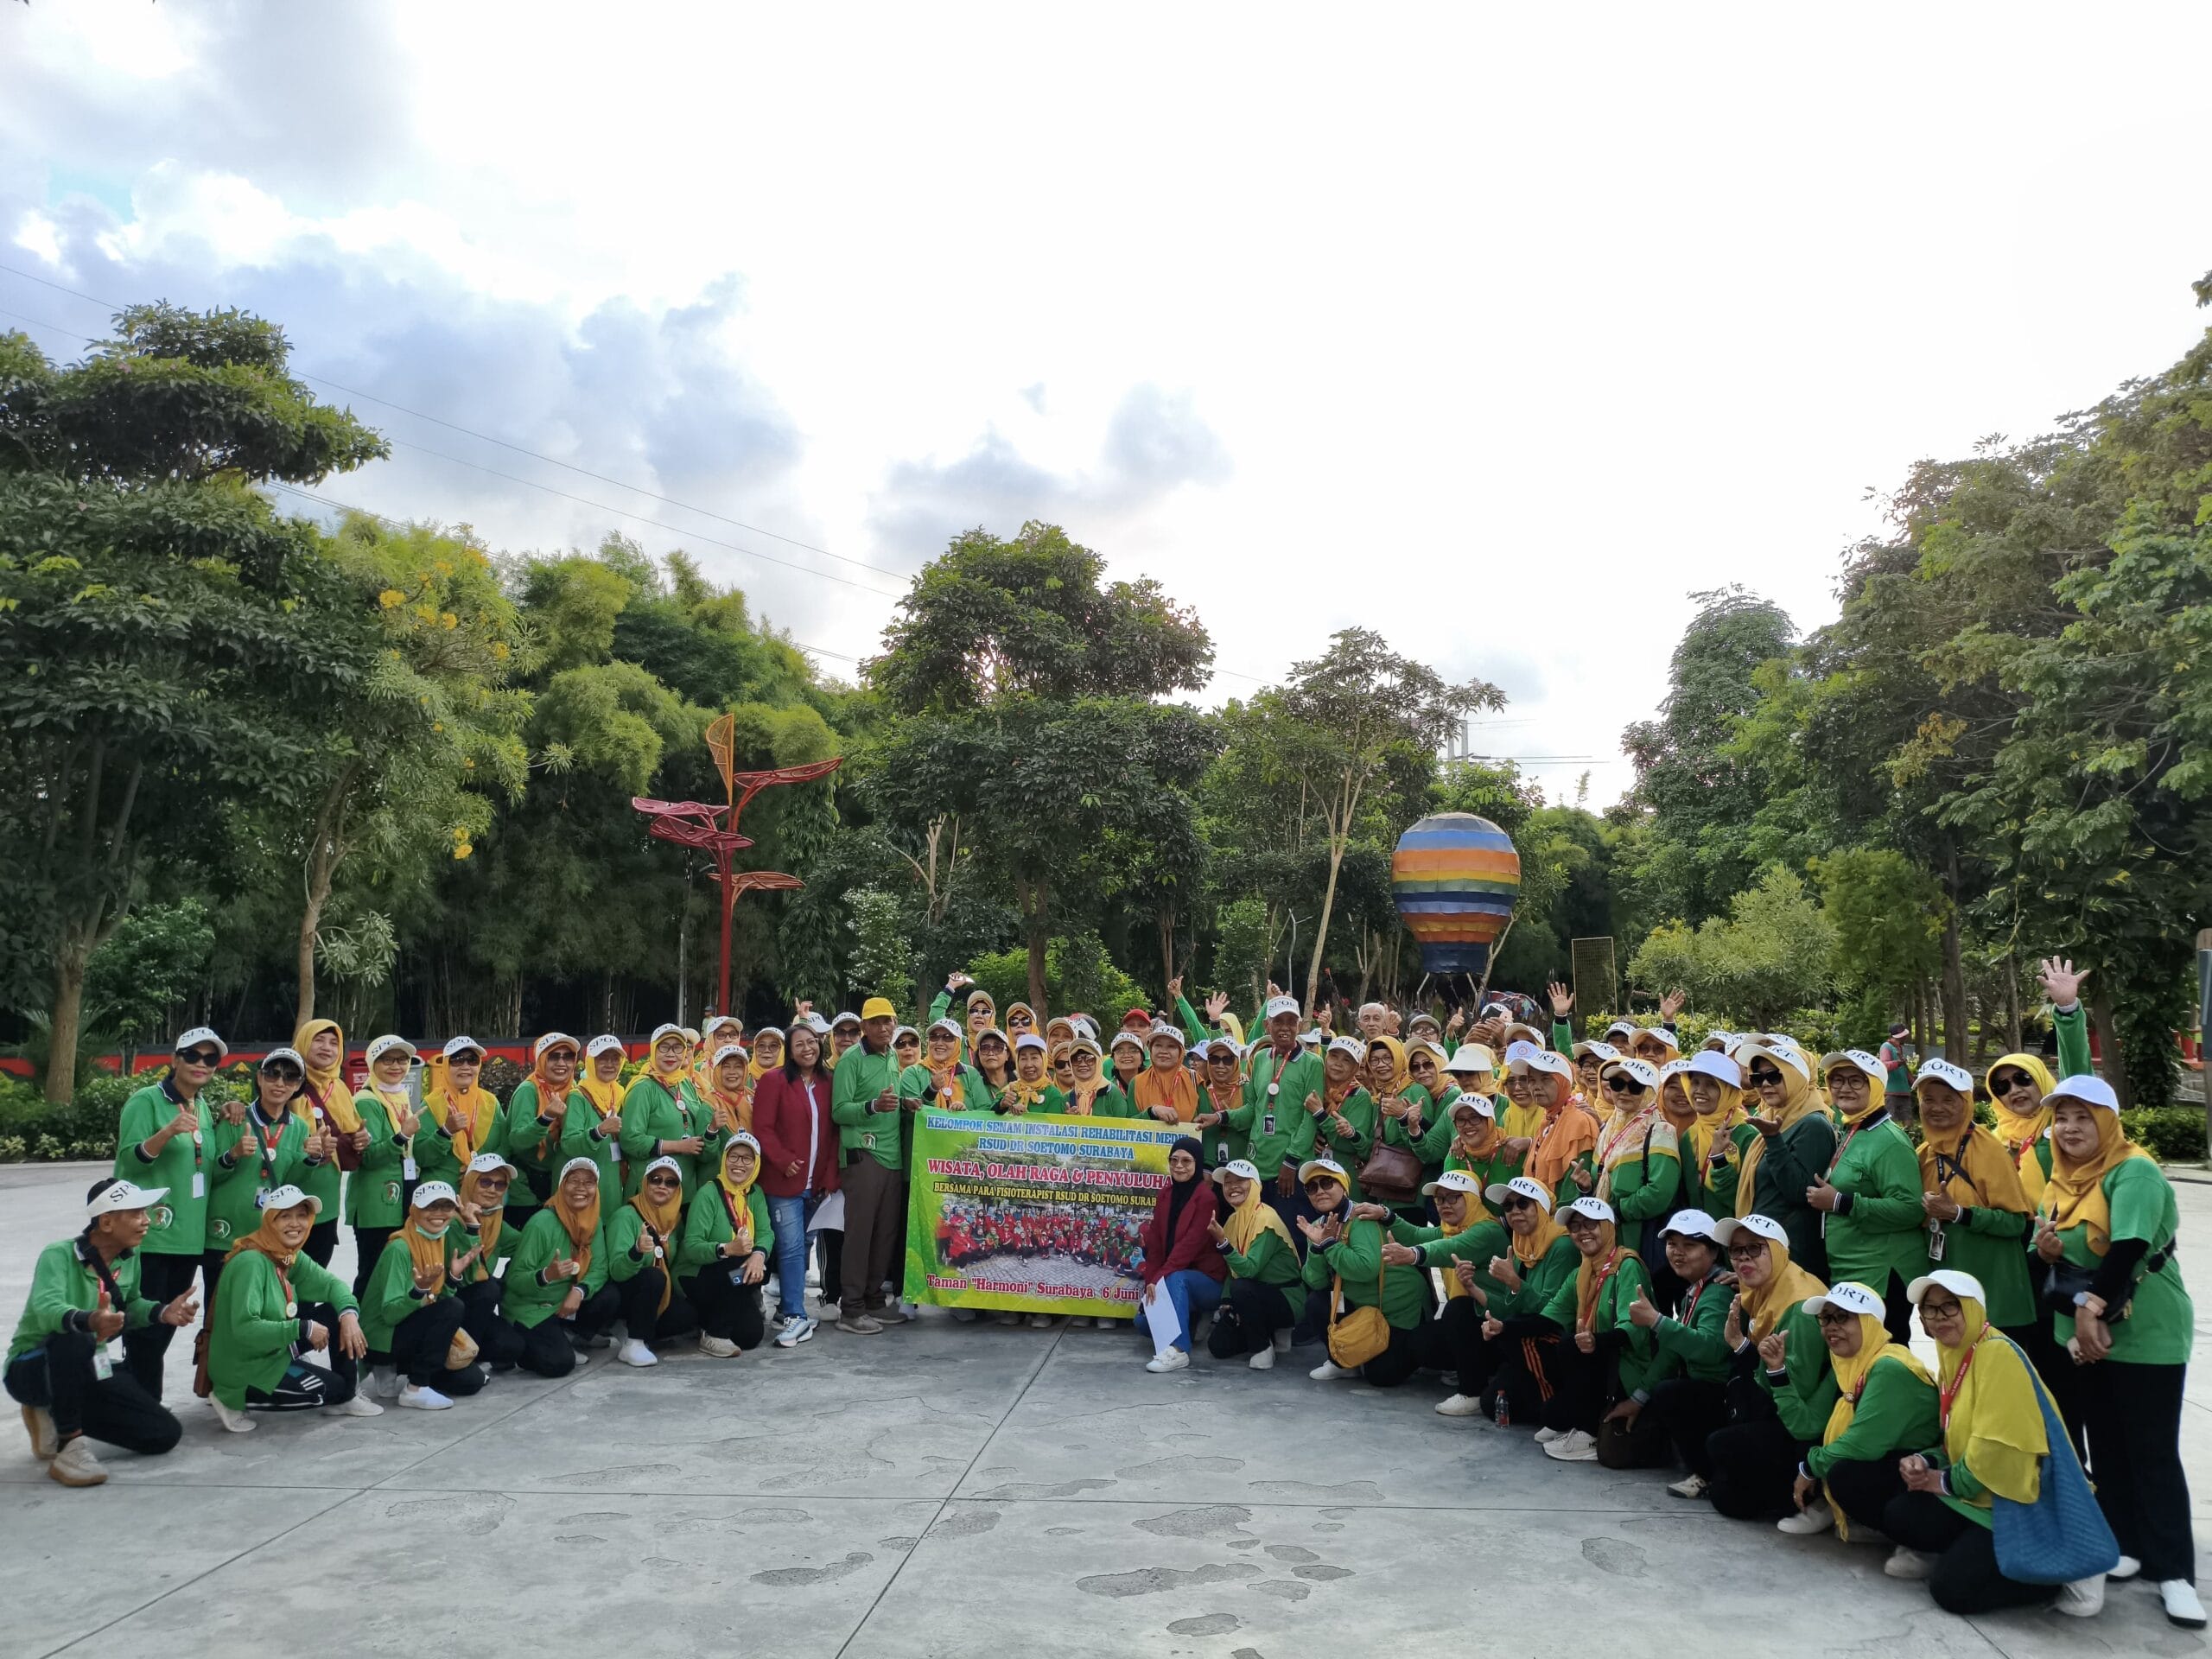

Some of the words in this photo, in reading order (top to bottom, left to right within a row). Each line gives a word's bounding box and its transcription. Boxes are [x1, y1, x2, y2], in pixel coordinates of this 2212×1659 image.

[1624, 1061, 1654, 1077] ORT
[1459, 1096, 1490, 1108] ORT
[927, 1116, 983, 1132] KELOMPOK
[986, 1121, 1022, 1134] SENAM
[1025, 1123, 1078, 1138] INSTALASI
[1081, 1127, 1153, 1143] REHABILITASI
[1155, 1132, 1190, 1145] MED
[978, 1138, 1007, 1151] RSUD
[1009, 1140, 1025, 1152] DR
[1027, 1141, 1077, 1156] SOETOMO
[1079, 1144, 1135, 1160] SURABAYA
[474, 1153, 504, 1165] SPO
[927, 1159, 985, 1179] WISATA,
[987, 1163, 1027, 1179] OLAH
[1029, 1165, 1069, 1183] RAGA
[1071, 1168, 1084, 1183] &
[1085, 1169, 1173, 1190] PENYULUHA
[1441, 1173, 1469, 1185] ORT
[934, 1182, 972, 1194] BERSAMA
[973, 1185, 995, 1196] PARA
[996, 1186, 1054, 1199] FISIOTERAPIST
[1055, 1191, 1077, 1202] RSUD
[1078, 1192, 1090, 1203] DR
[1090, 1193, 1128, 1205] SOETOMO
[1129, 1195, 1156, 1207] SURAB
[1574, 1199, 1605, 1211] ORT
[926, 1274, 967, 1289] Taman
[1102, 1286, 1110, 1299] 6
[1113, 1287, 1140, 1300] Juni
[1830, 1287, 1870, 1306] ORT
